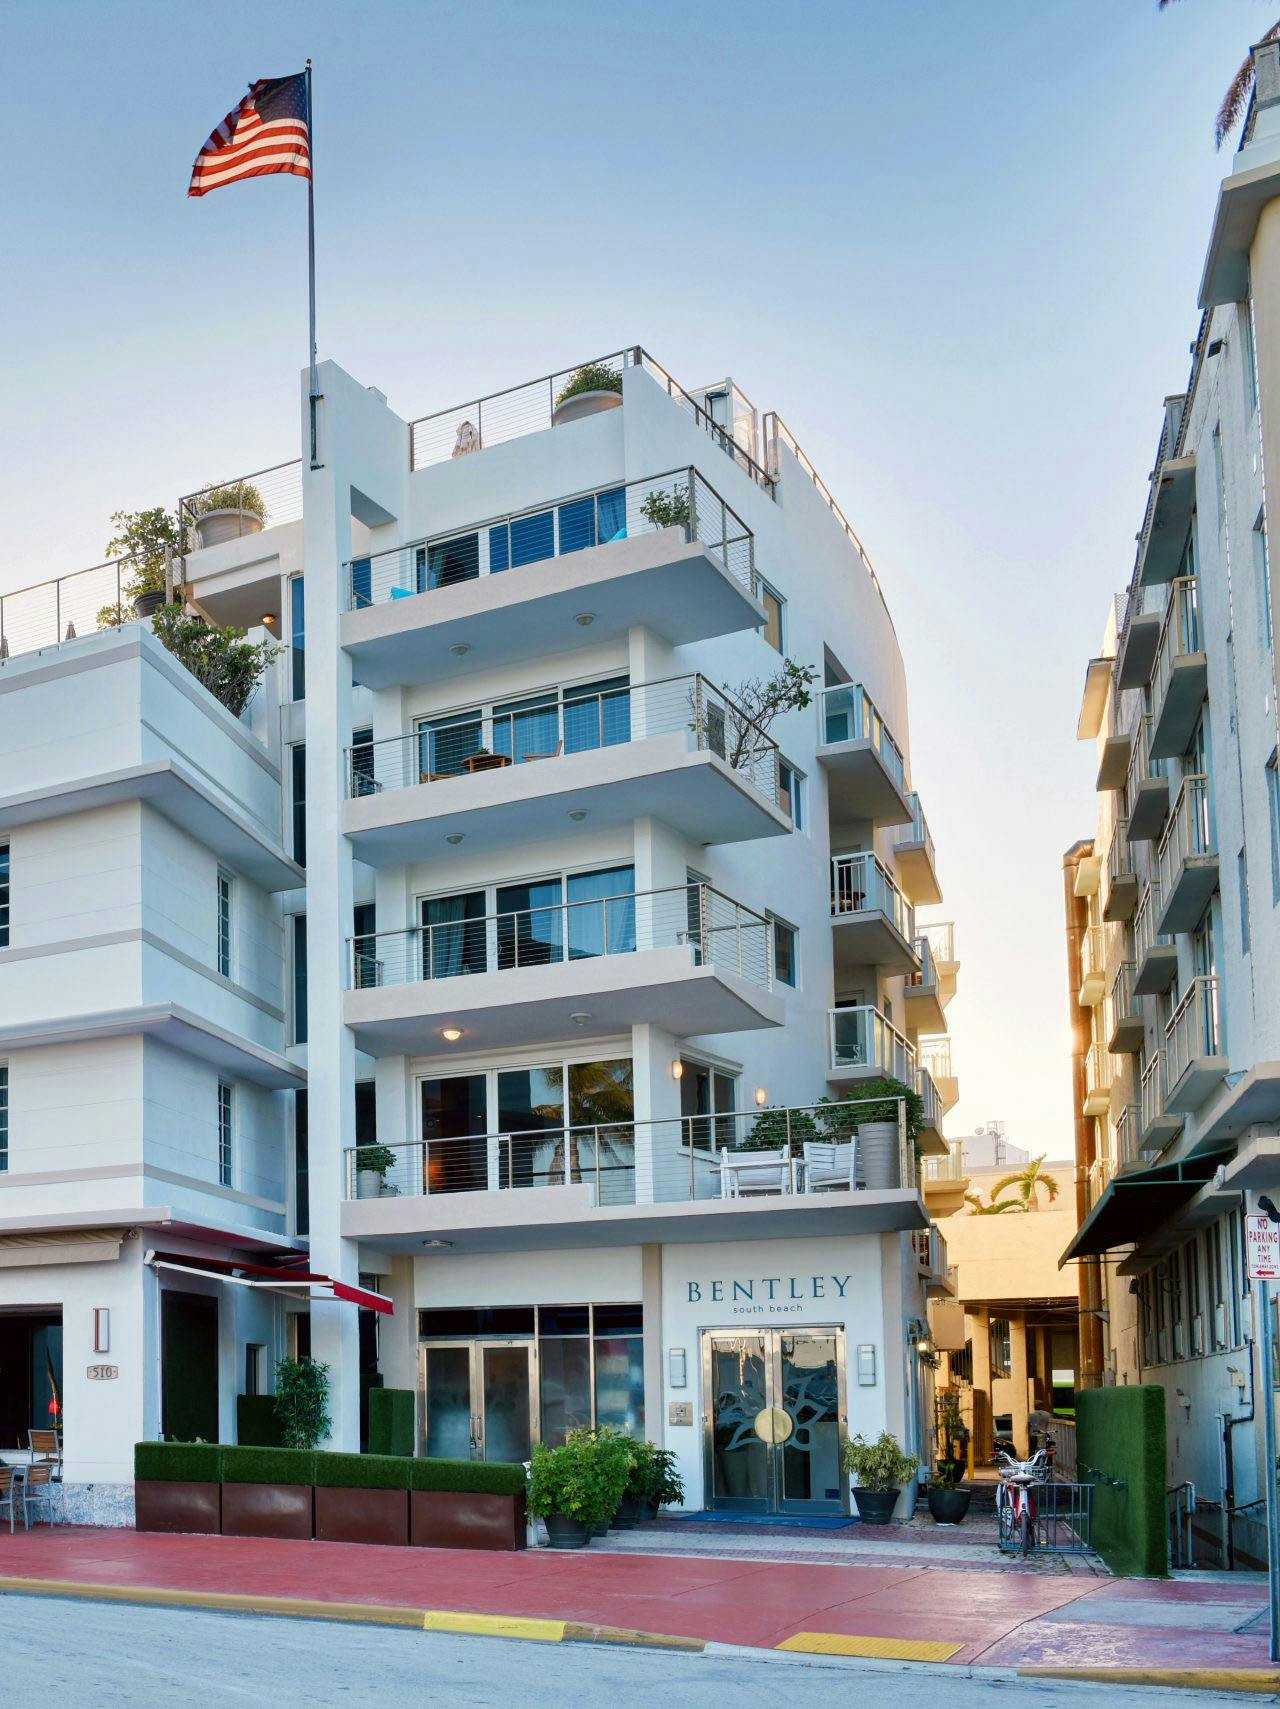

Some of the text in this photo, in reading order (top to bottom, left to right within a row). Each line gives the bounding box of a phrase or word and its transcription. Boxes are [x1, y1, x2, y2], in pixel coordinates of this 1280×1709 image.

[1257, 1218, 1268, 1230] NO
[1248, 1231, 1278, 1243] PARKING
[1257, 1245, 1270, 1253] ANY
[1257, 1254, 1271, 1262] TIME
[687, 1275, 852, 1303] BENTLEY
[733, 1303, 803, 1314] south beach
[93, 1366, 112, 1378] 510
